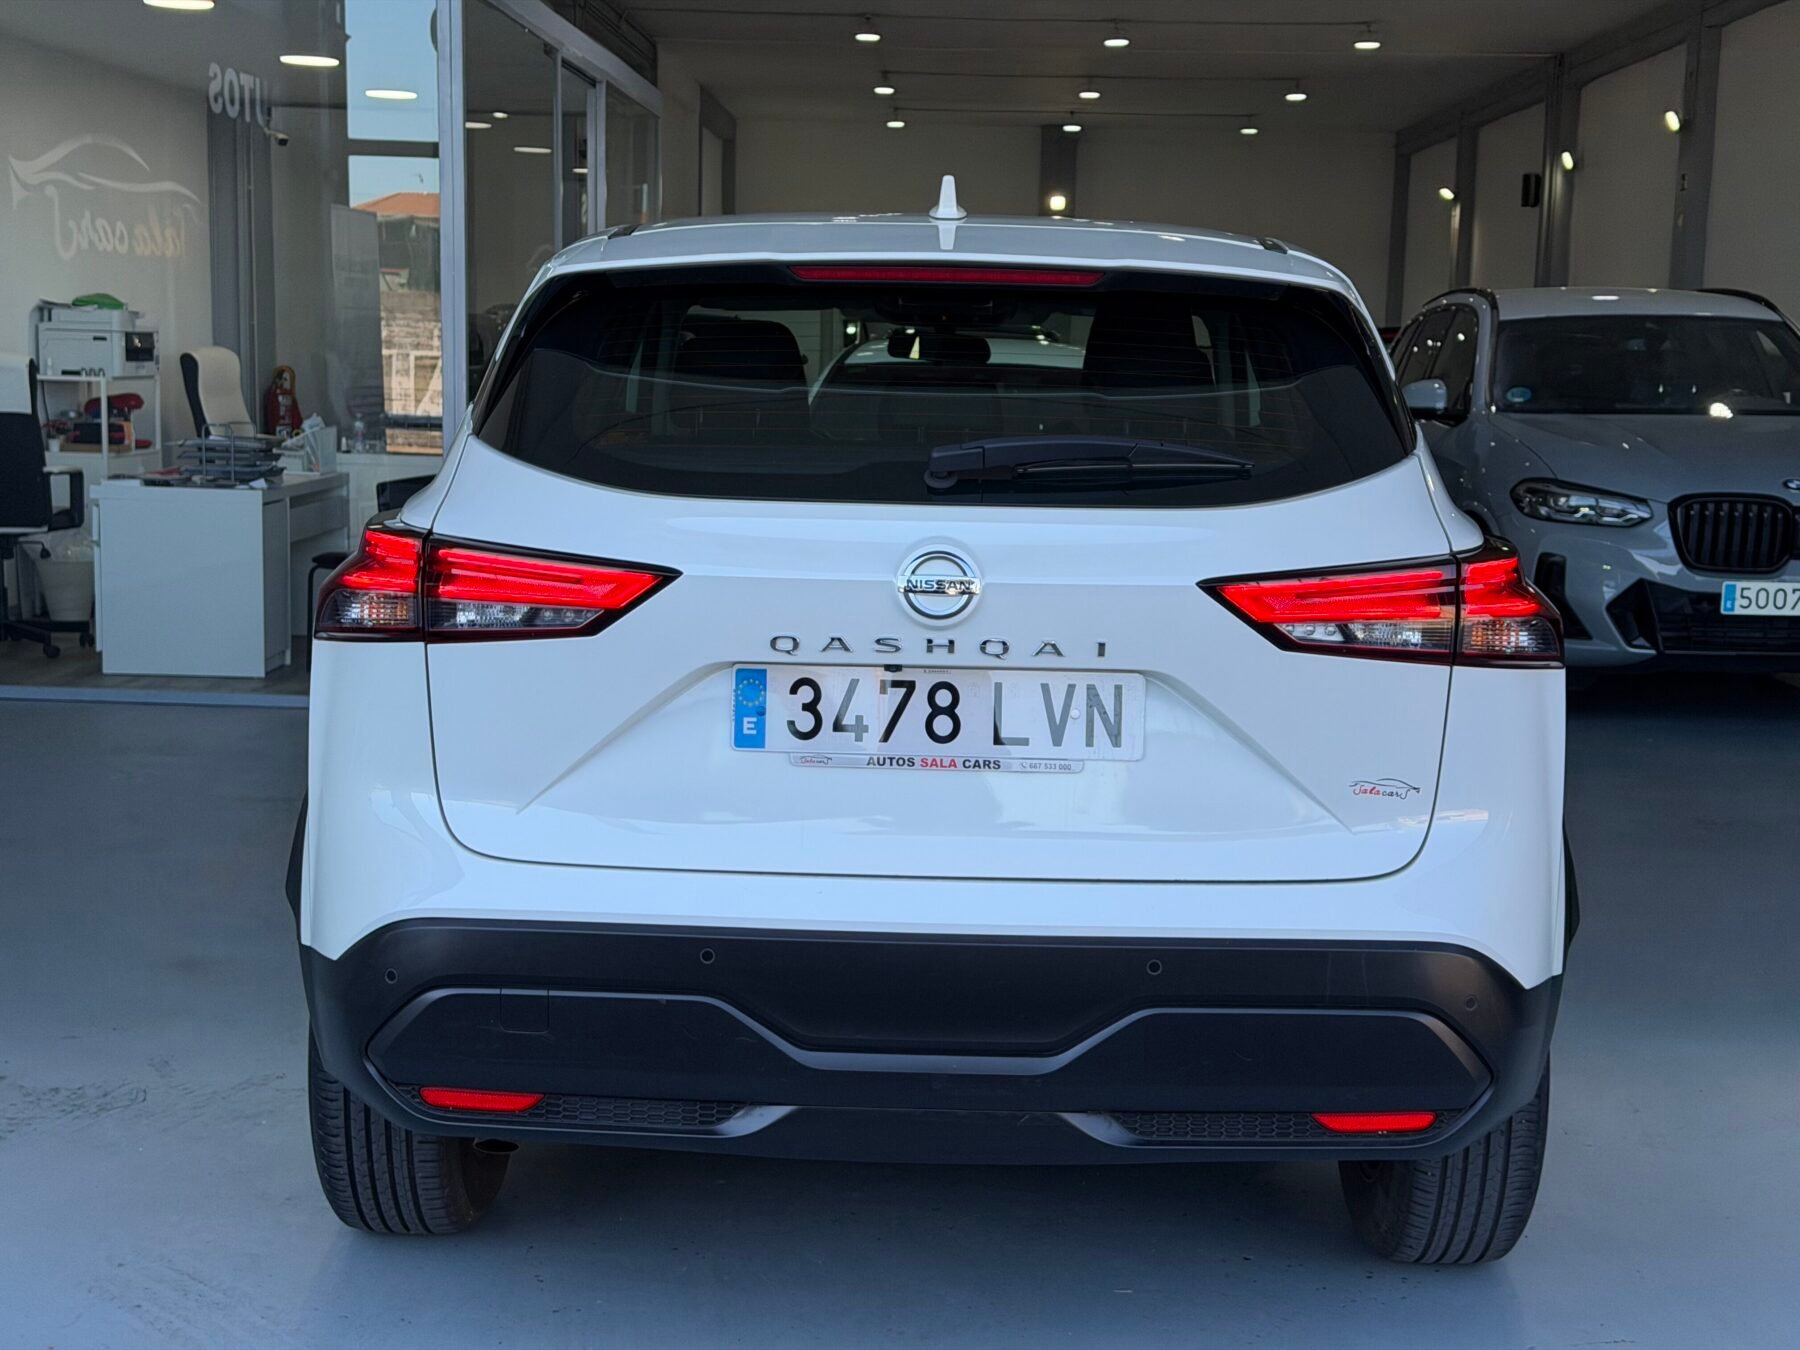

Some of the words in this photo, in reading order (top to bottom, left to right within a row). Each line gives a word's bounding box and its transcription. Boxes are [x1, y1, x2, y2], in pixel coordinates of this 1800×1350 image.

[906, 578, 971, 591] NISSAN
[1739, 587, 1800, 610] 5007
[769, 635, 1107, 661] QASHQAI
[786, 677, 961, 745] 3478
[993, 681, 1123, 748] LVN
[742, 716, 758, 735] E
[866, 756, 915, 768] AUTOS
[920, 757, 958, 769] SALA
[962, 758, 1001, 770] CARS
